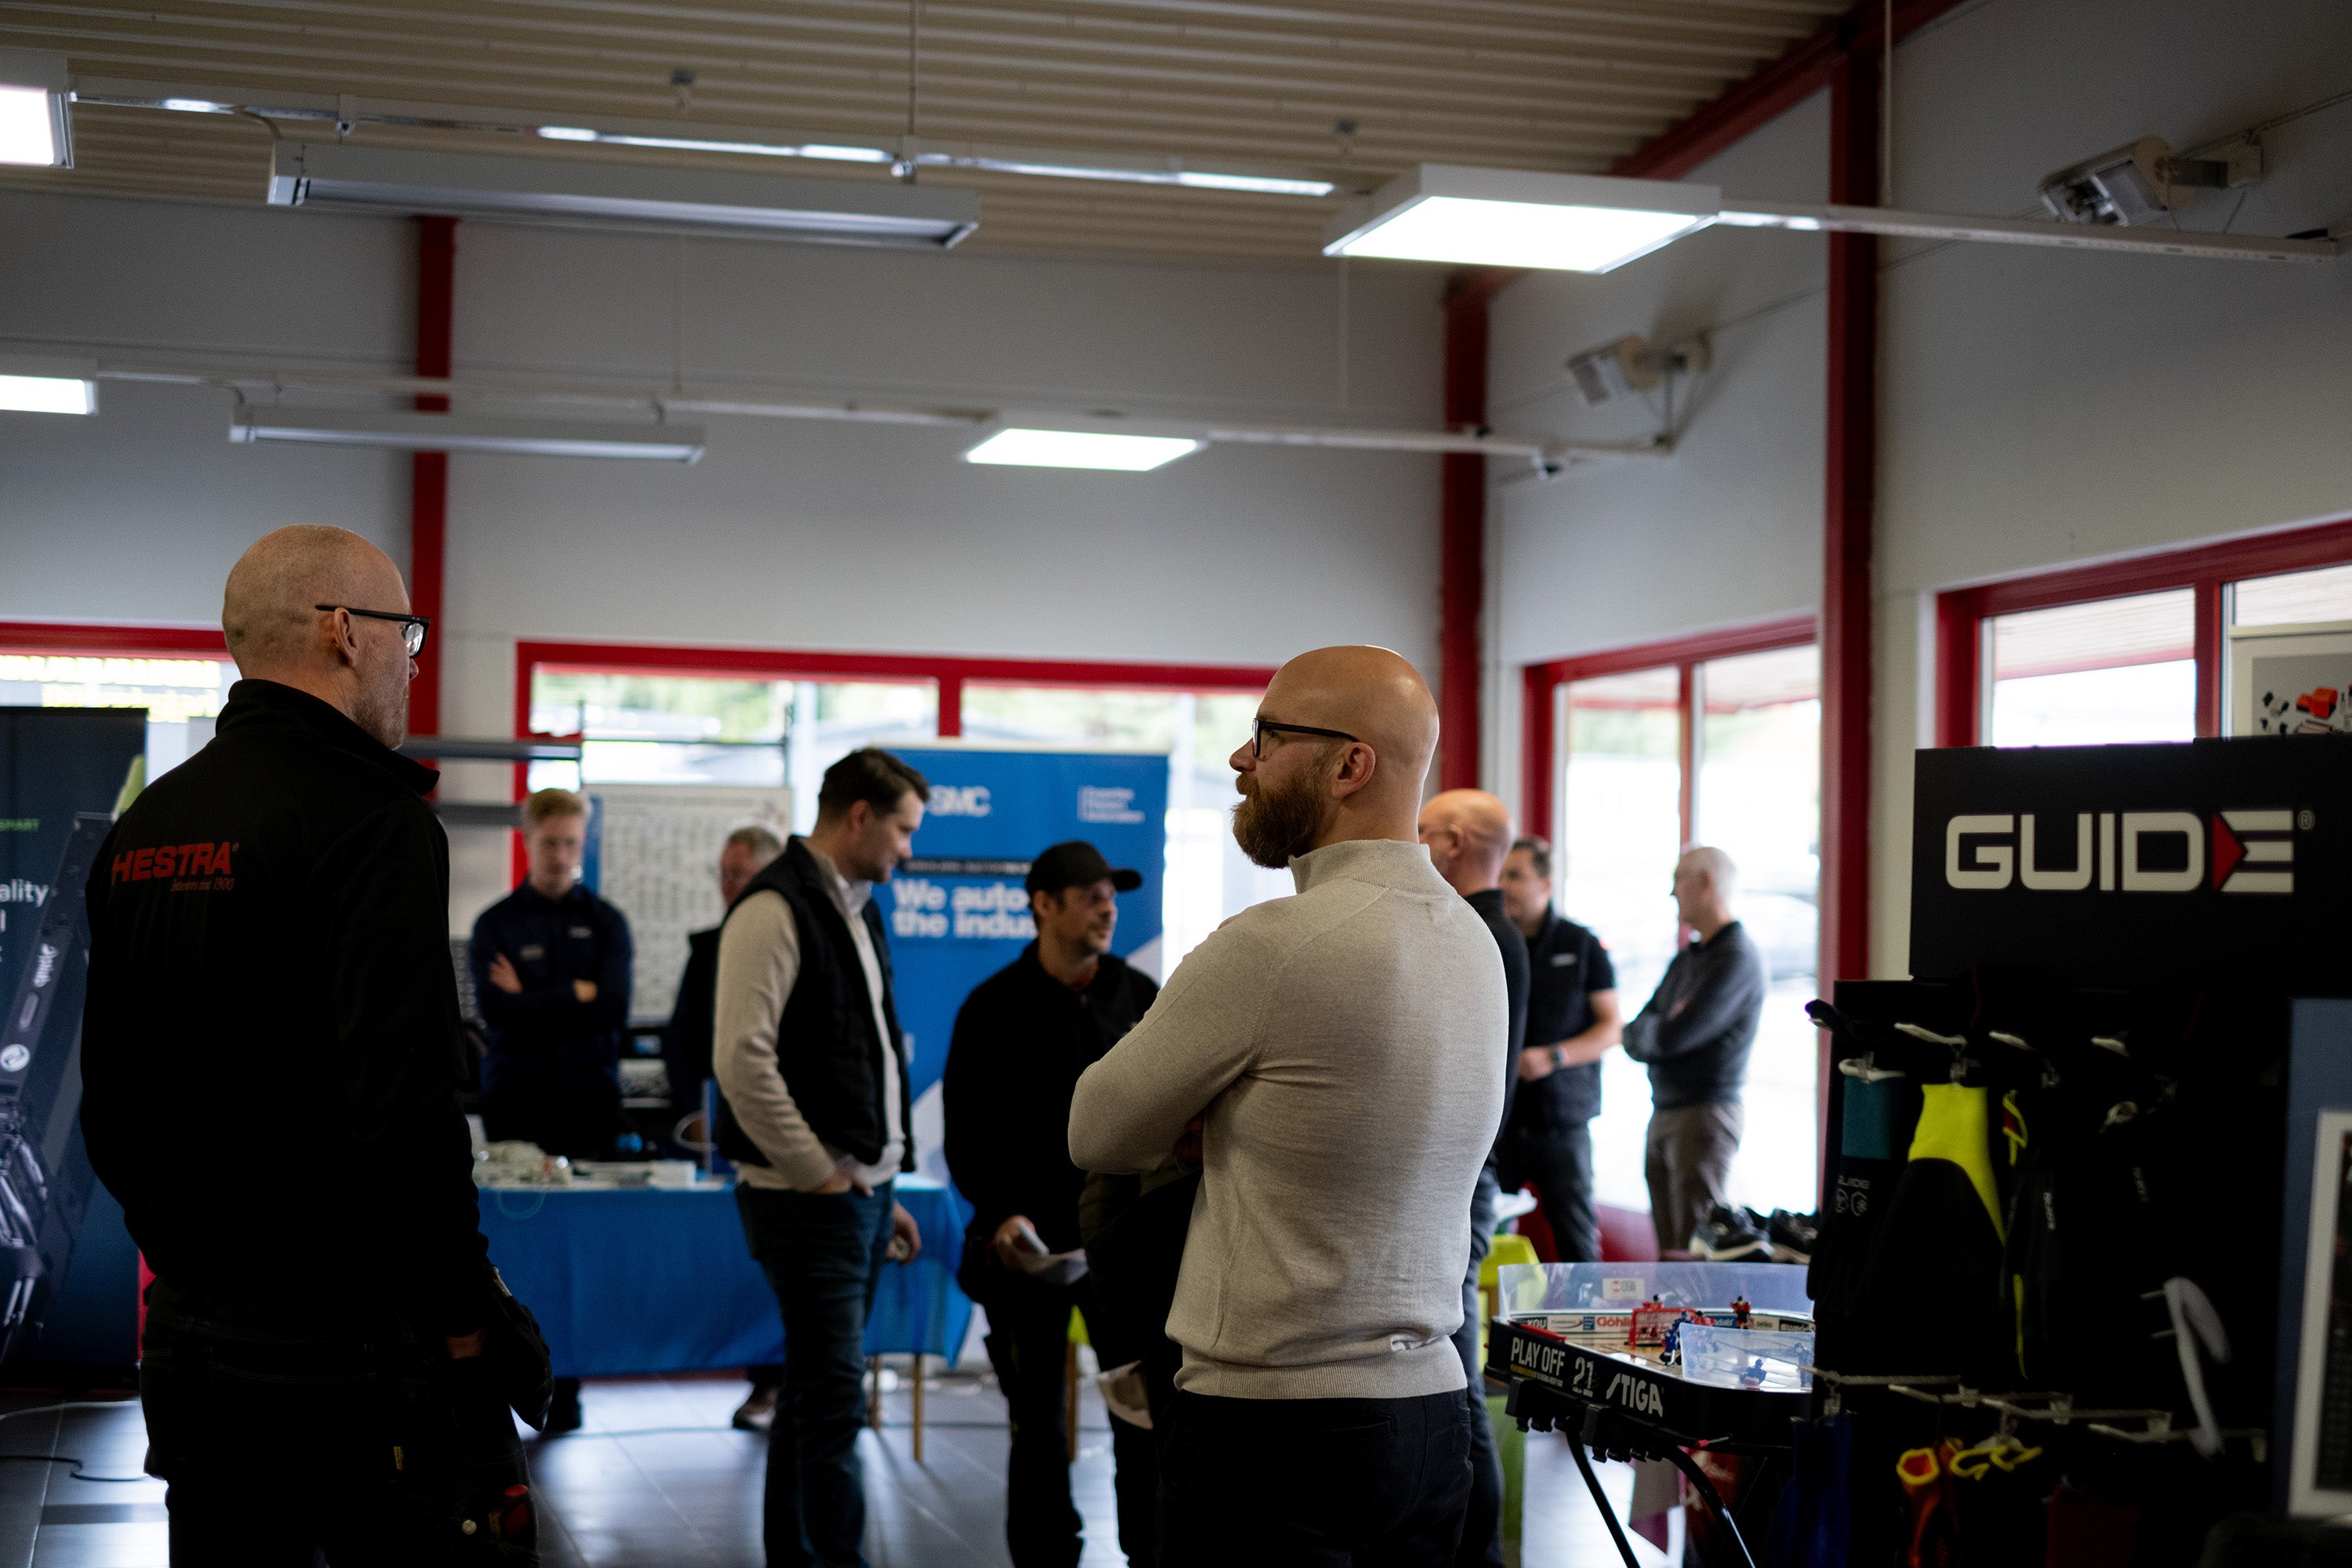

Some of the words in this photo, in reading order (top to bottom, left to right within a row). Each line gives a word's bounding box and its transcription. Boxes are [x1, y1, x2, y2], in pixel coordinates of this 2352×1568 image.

[891, 878, 948, 910] We
[891, 907, 949, 938] the
[1510, 1337, 1541, 1369] PLAY
[1541, 1345, 1566, 1377] OFF
[1571, 1356, 1595, 1399] 21
[1606, 1373, 1664, 1418] STIGA
